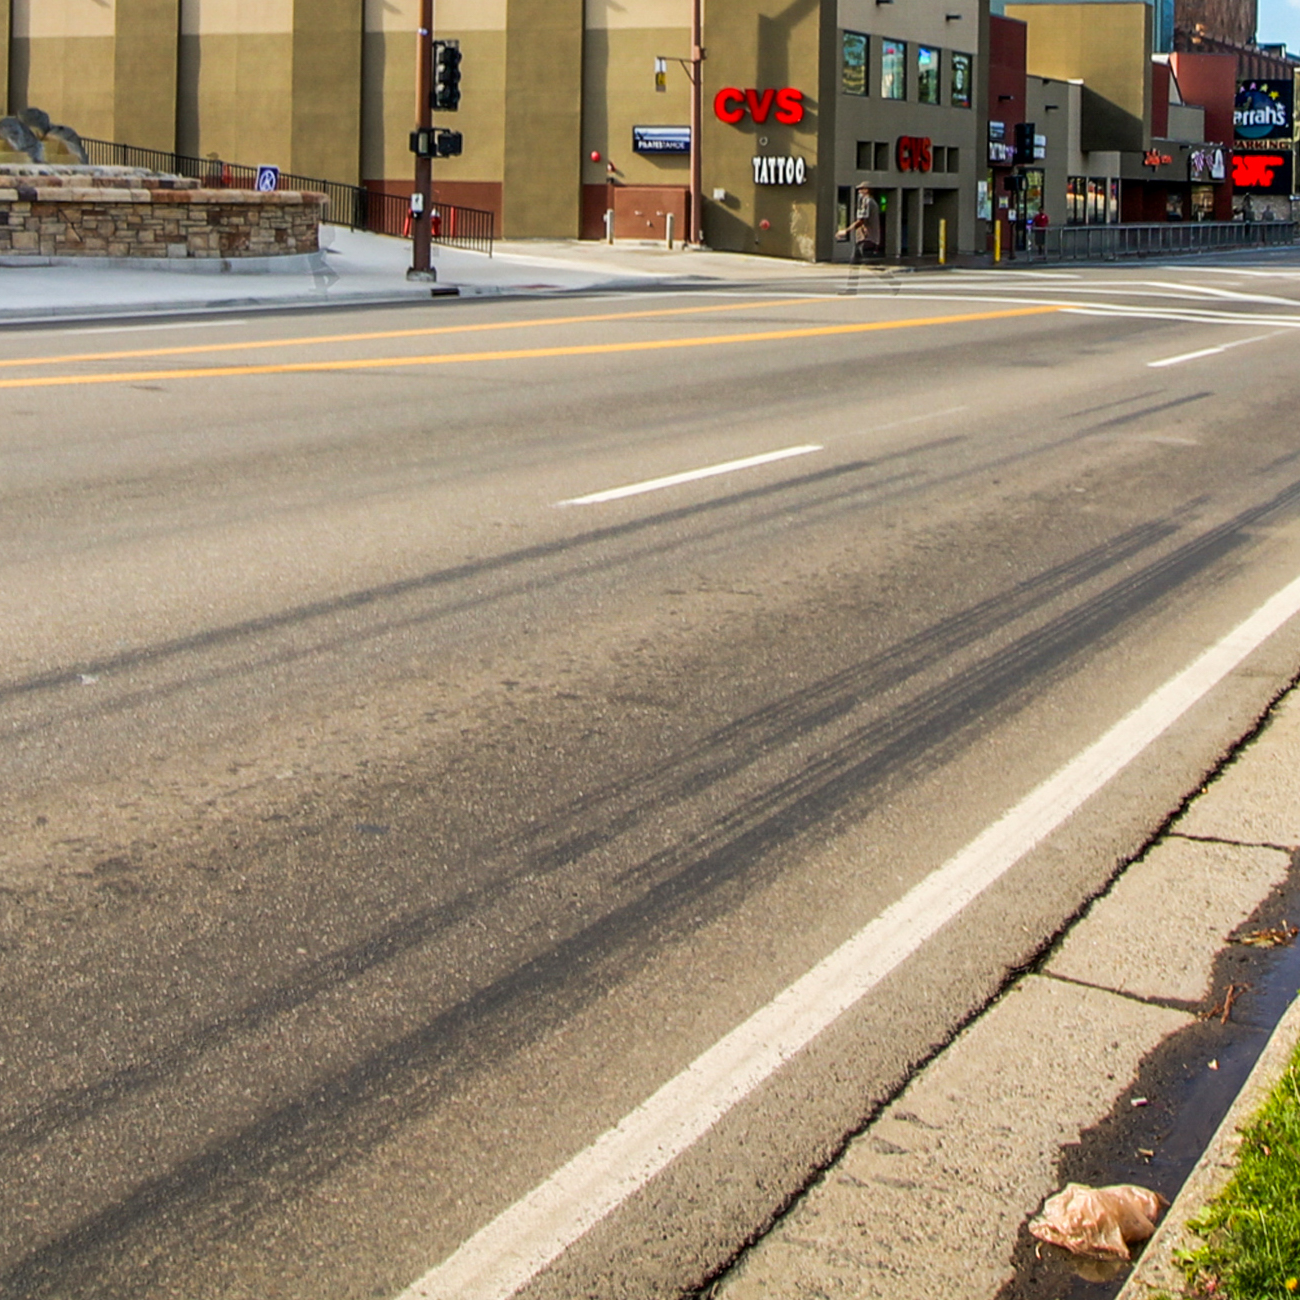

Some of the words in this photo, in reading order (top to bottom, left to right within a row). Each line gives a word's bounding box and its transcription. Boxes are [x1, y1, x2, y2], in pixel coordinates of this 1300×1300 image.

[713, 87, 804, 125] CVS
[753, 157, 805, 184] TATTOO
[897, 135, 931, 172] CVS
